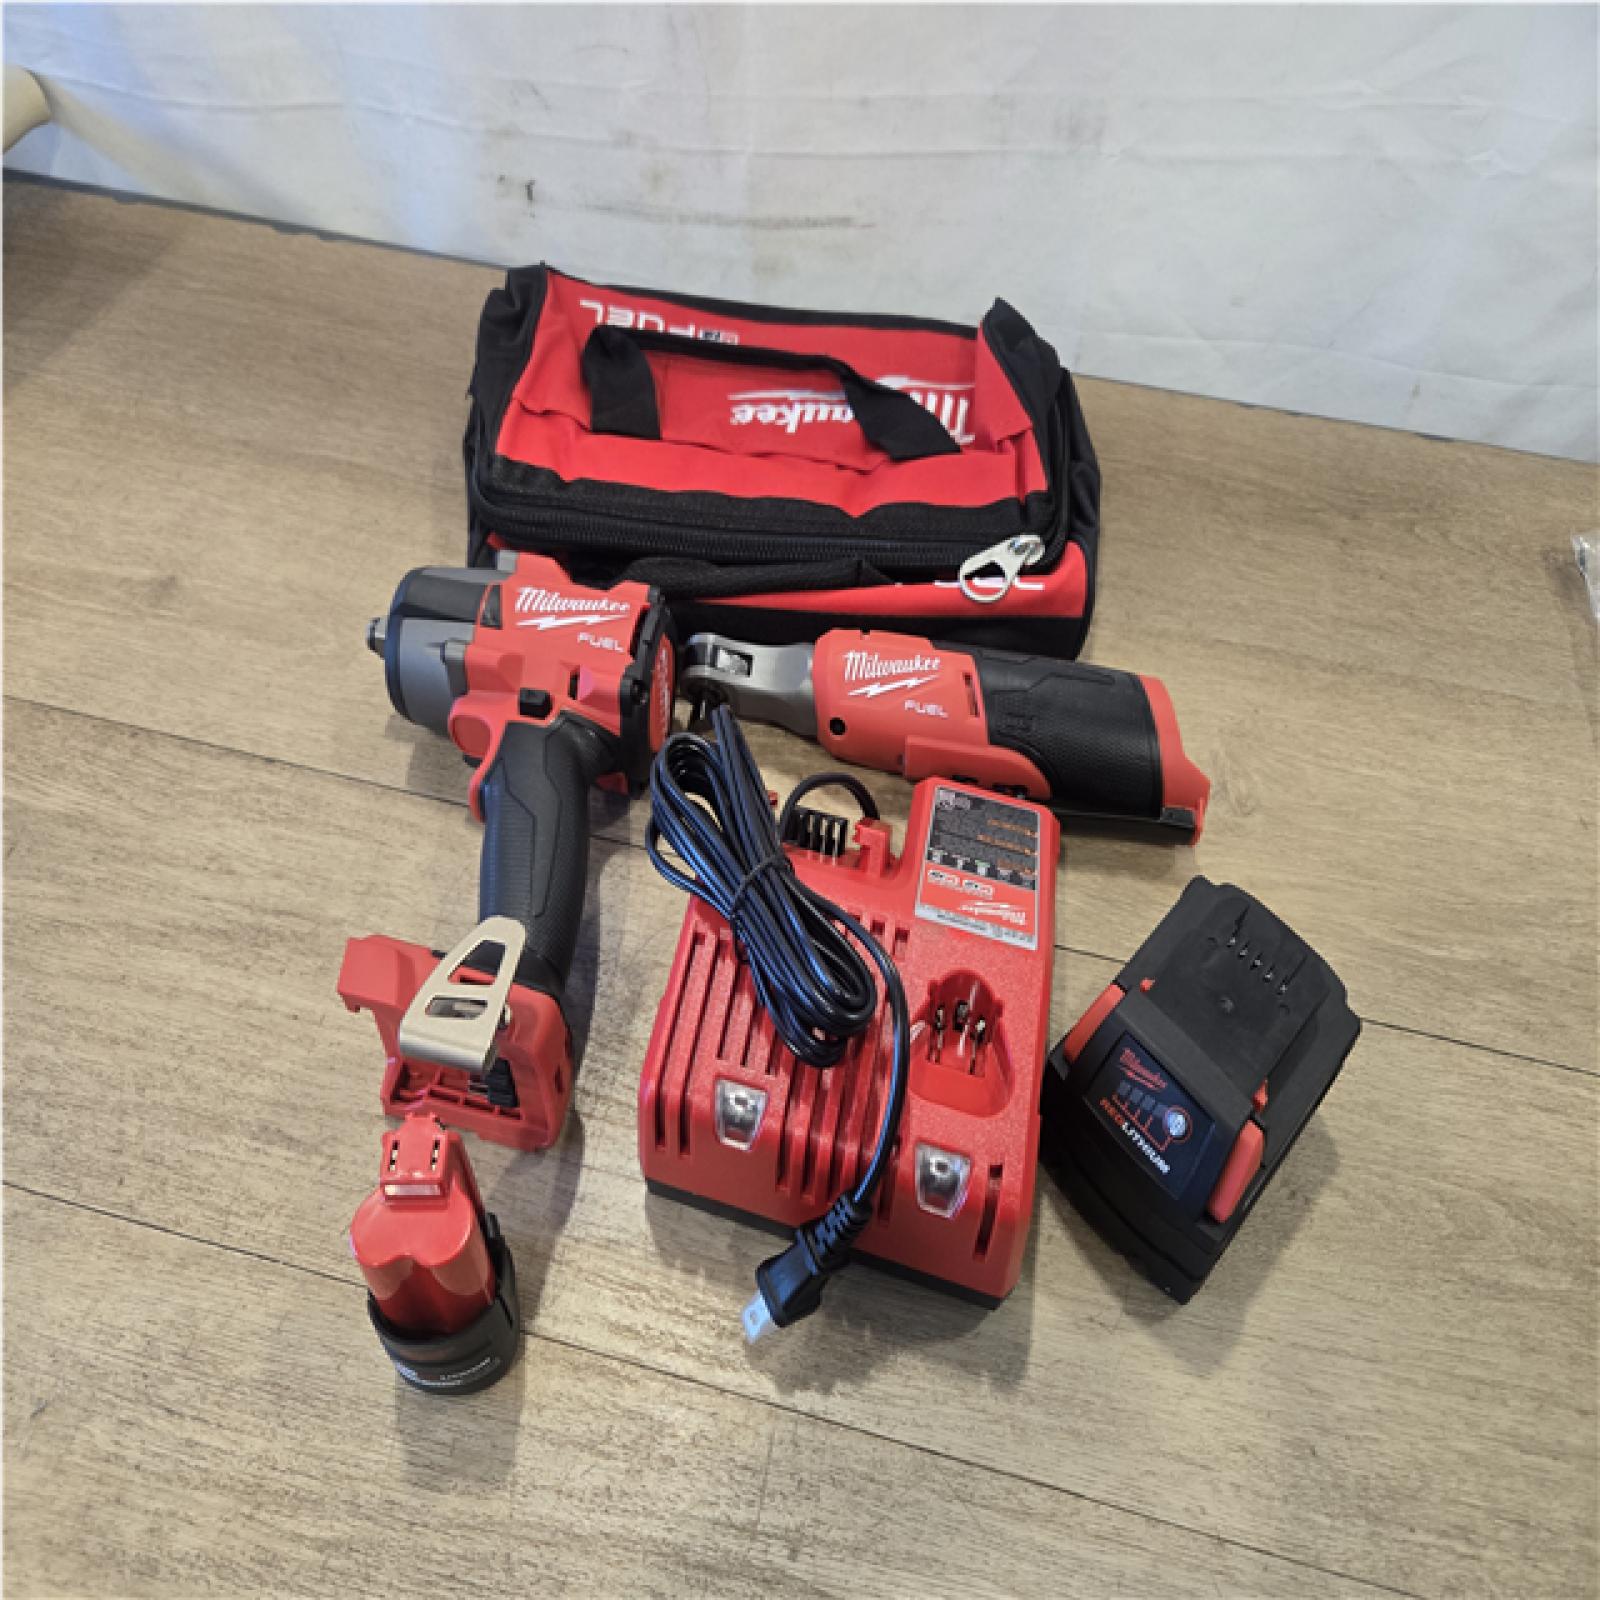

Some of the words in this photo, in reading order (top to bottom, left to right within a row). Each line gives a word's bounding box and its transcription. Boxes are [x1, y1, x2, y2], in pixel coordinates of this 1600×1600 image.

[514, 586, 631, 613] Milwaukee
[577, 631, 625, 653] FUEL
[843, 649, 941, 682] Milwaukee
[904, 699, 949, 719] FUEL
